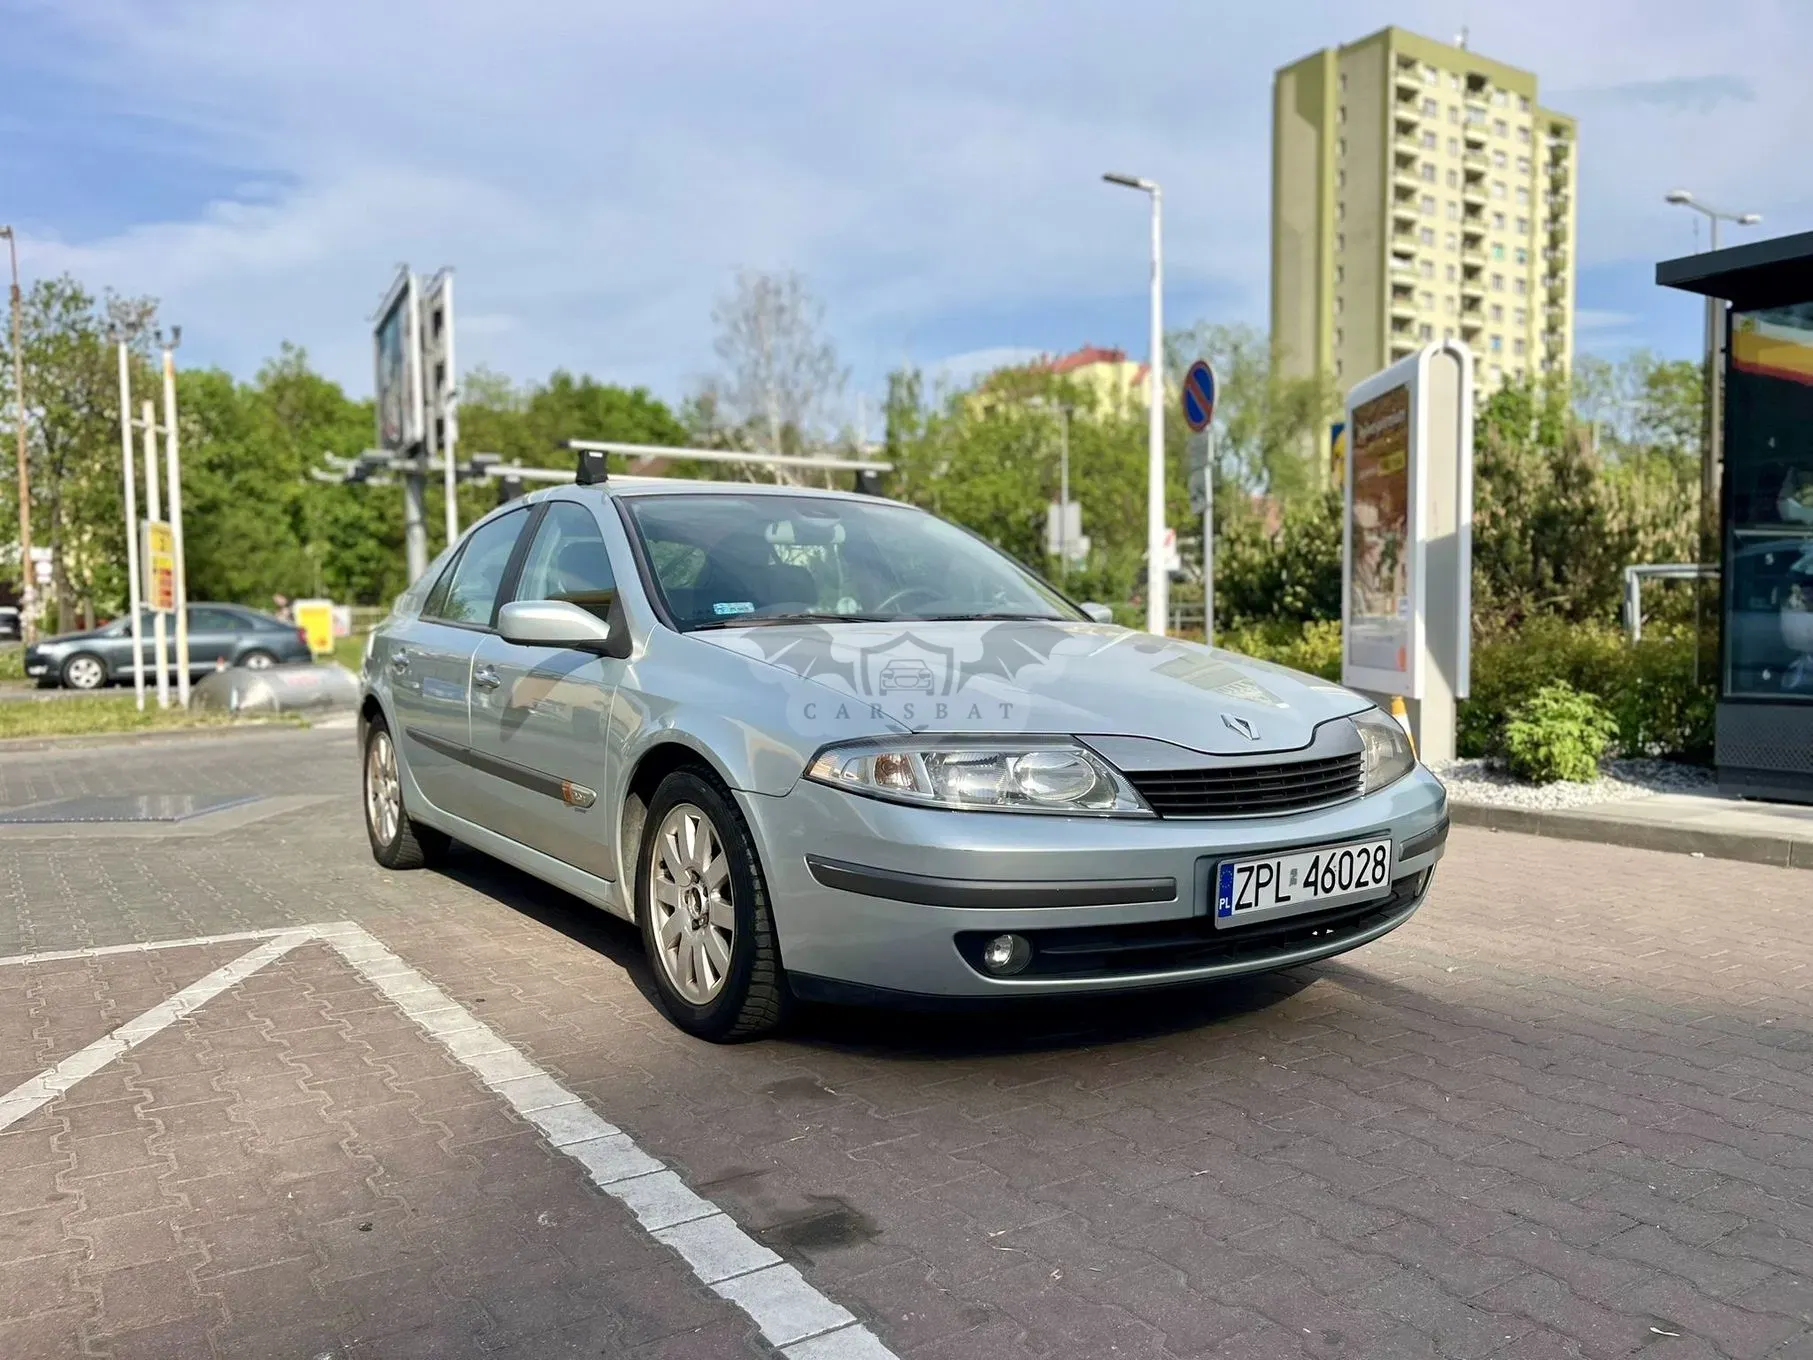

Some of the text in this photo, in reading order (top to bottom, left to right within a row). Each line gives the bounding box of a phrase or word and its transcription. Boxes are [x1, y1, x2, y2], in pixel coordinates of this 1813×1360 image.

[1235, 845, 1387, 910] ZPL 46028
[1219, 897, 1231, 910] PL
